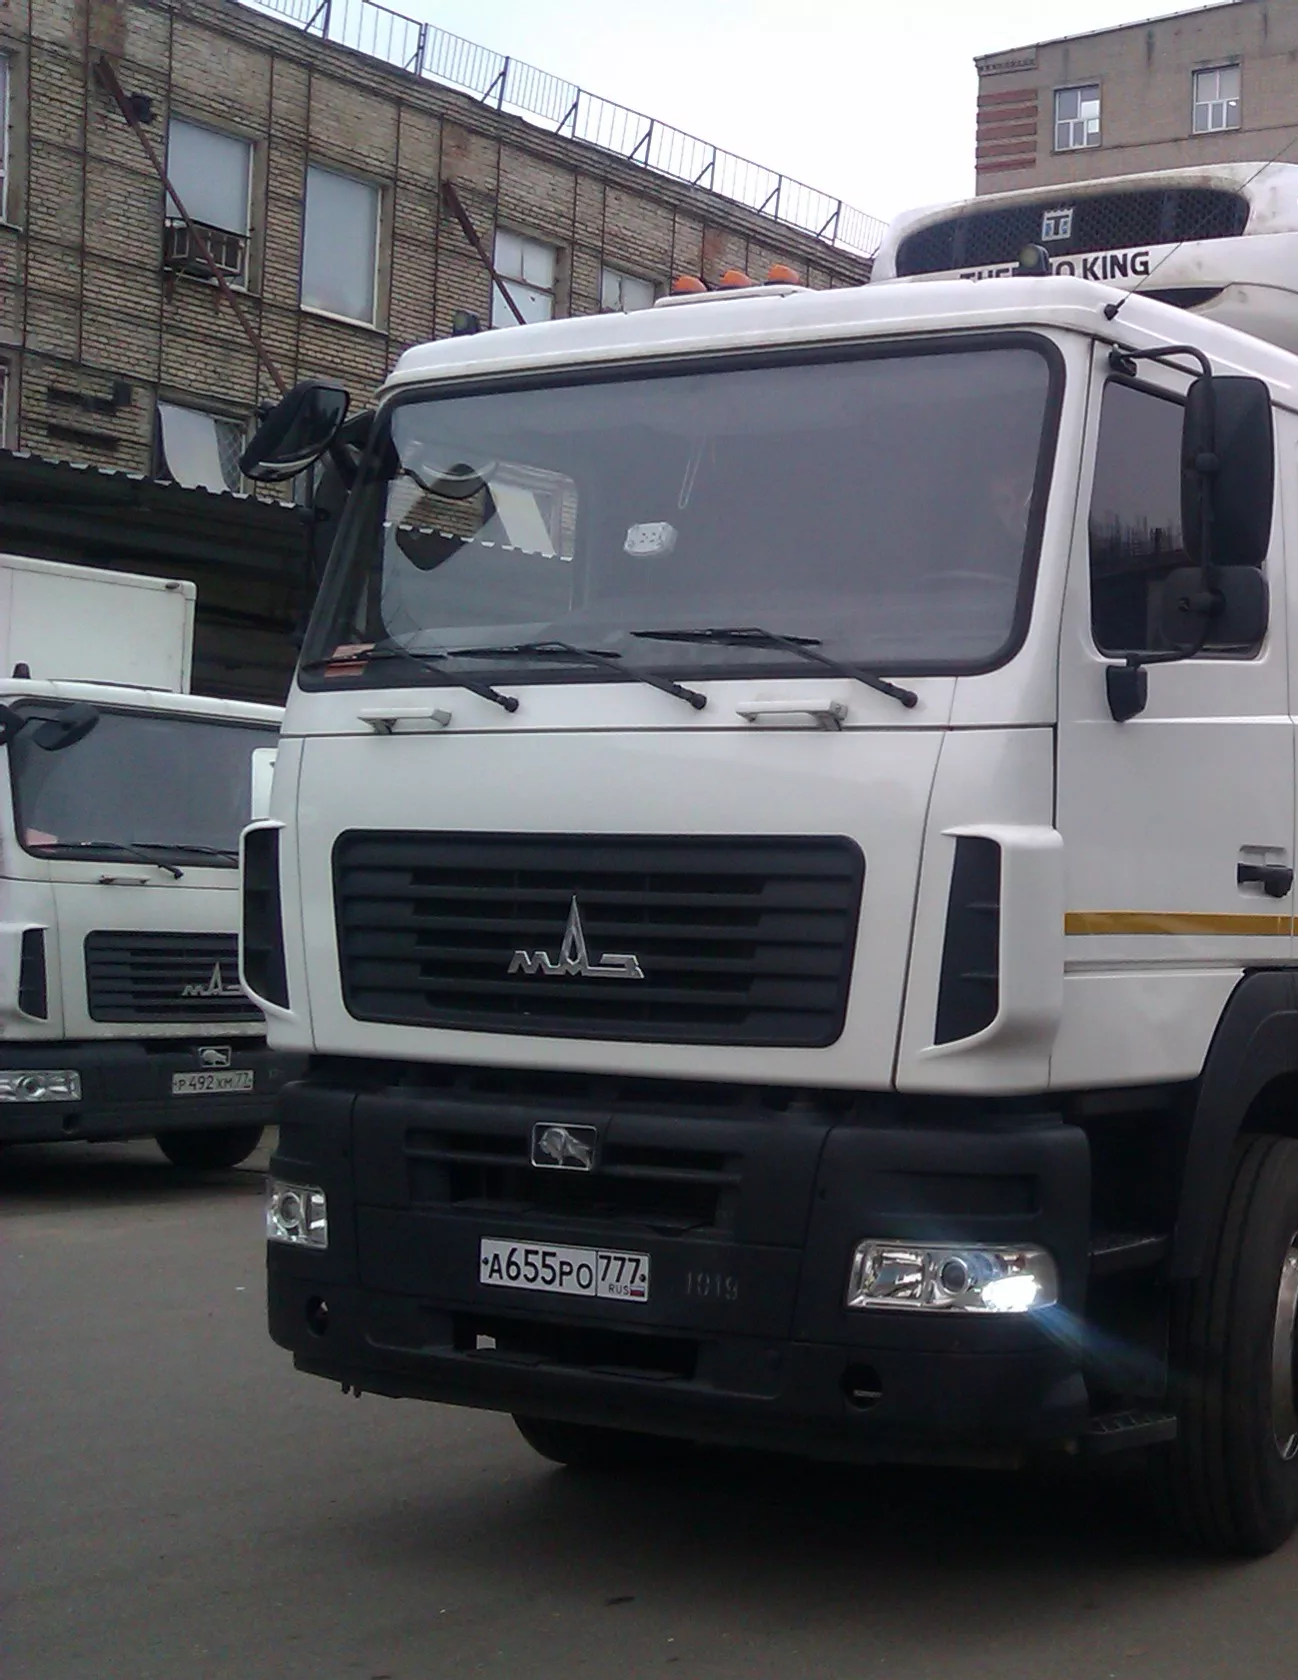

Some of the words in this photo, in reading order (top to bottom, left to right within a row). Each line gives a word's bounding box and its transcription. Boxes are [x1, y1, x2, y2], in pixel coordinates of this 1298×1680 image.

[1082, 251, 1151, 282] KING
[598, 1254, 641, 1284] 777
[608, 1283, 629, 1296] RUS
